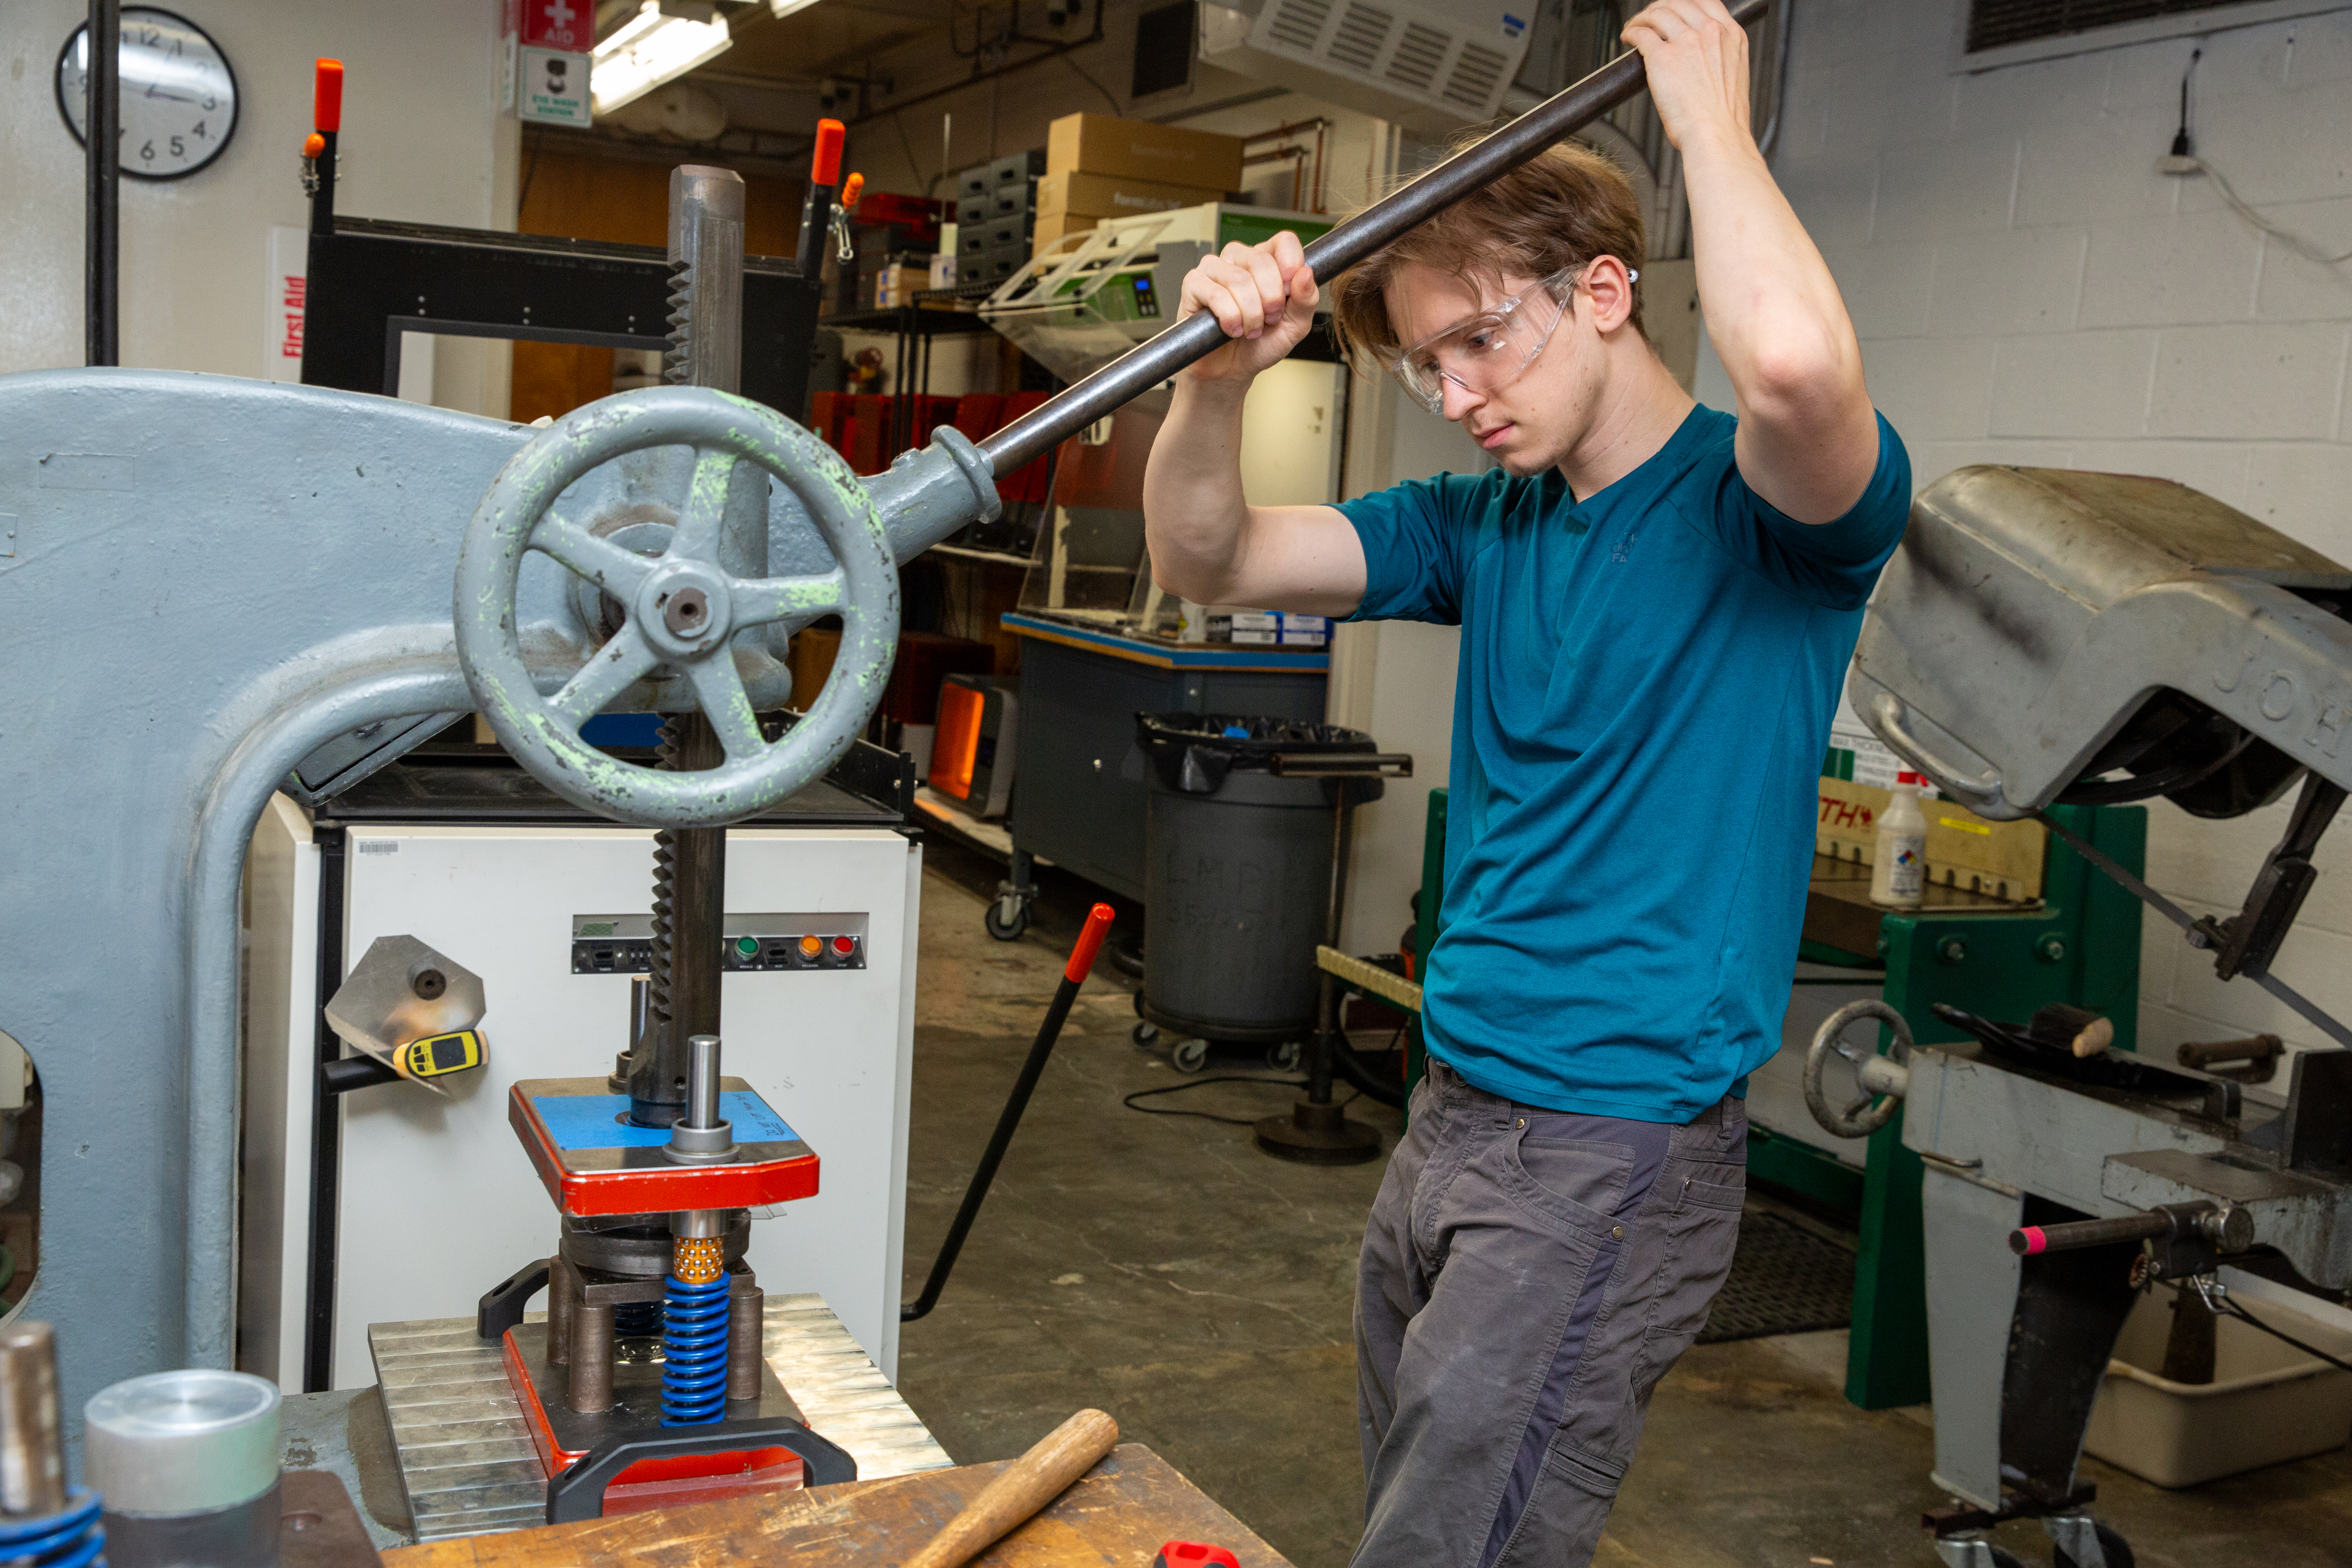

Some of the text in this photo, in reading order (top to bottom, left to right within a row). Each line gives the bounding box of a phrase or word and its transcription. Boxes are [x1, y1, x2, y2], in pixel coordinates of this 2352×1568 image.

[140, 29, 160, 47] 12
[544, 27, 575, 45] AID
[202, 96, 217, 111] 3
[192, 120, 206, 139] 4
[140, 139, 155, 160] 6
[170, 135, 184, 157] 5
[283, 275, 305, 358] First Aid
